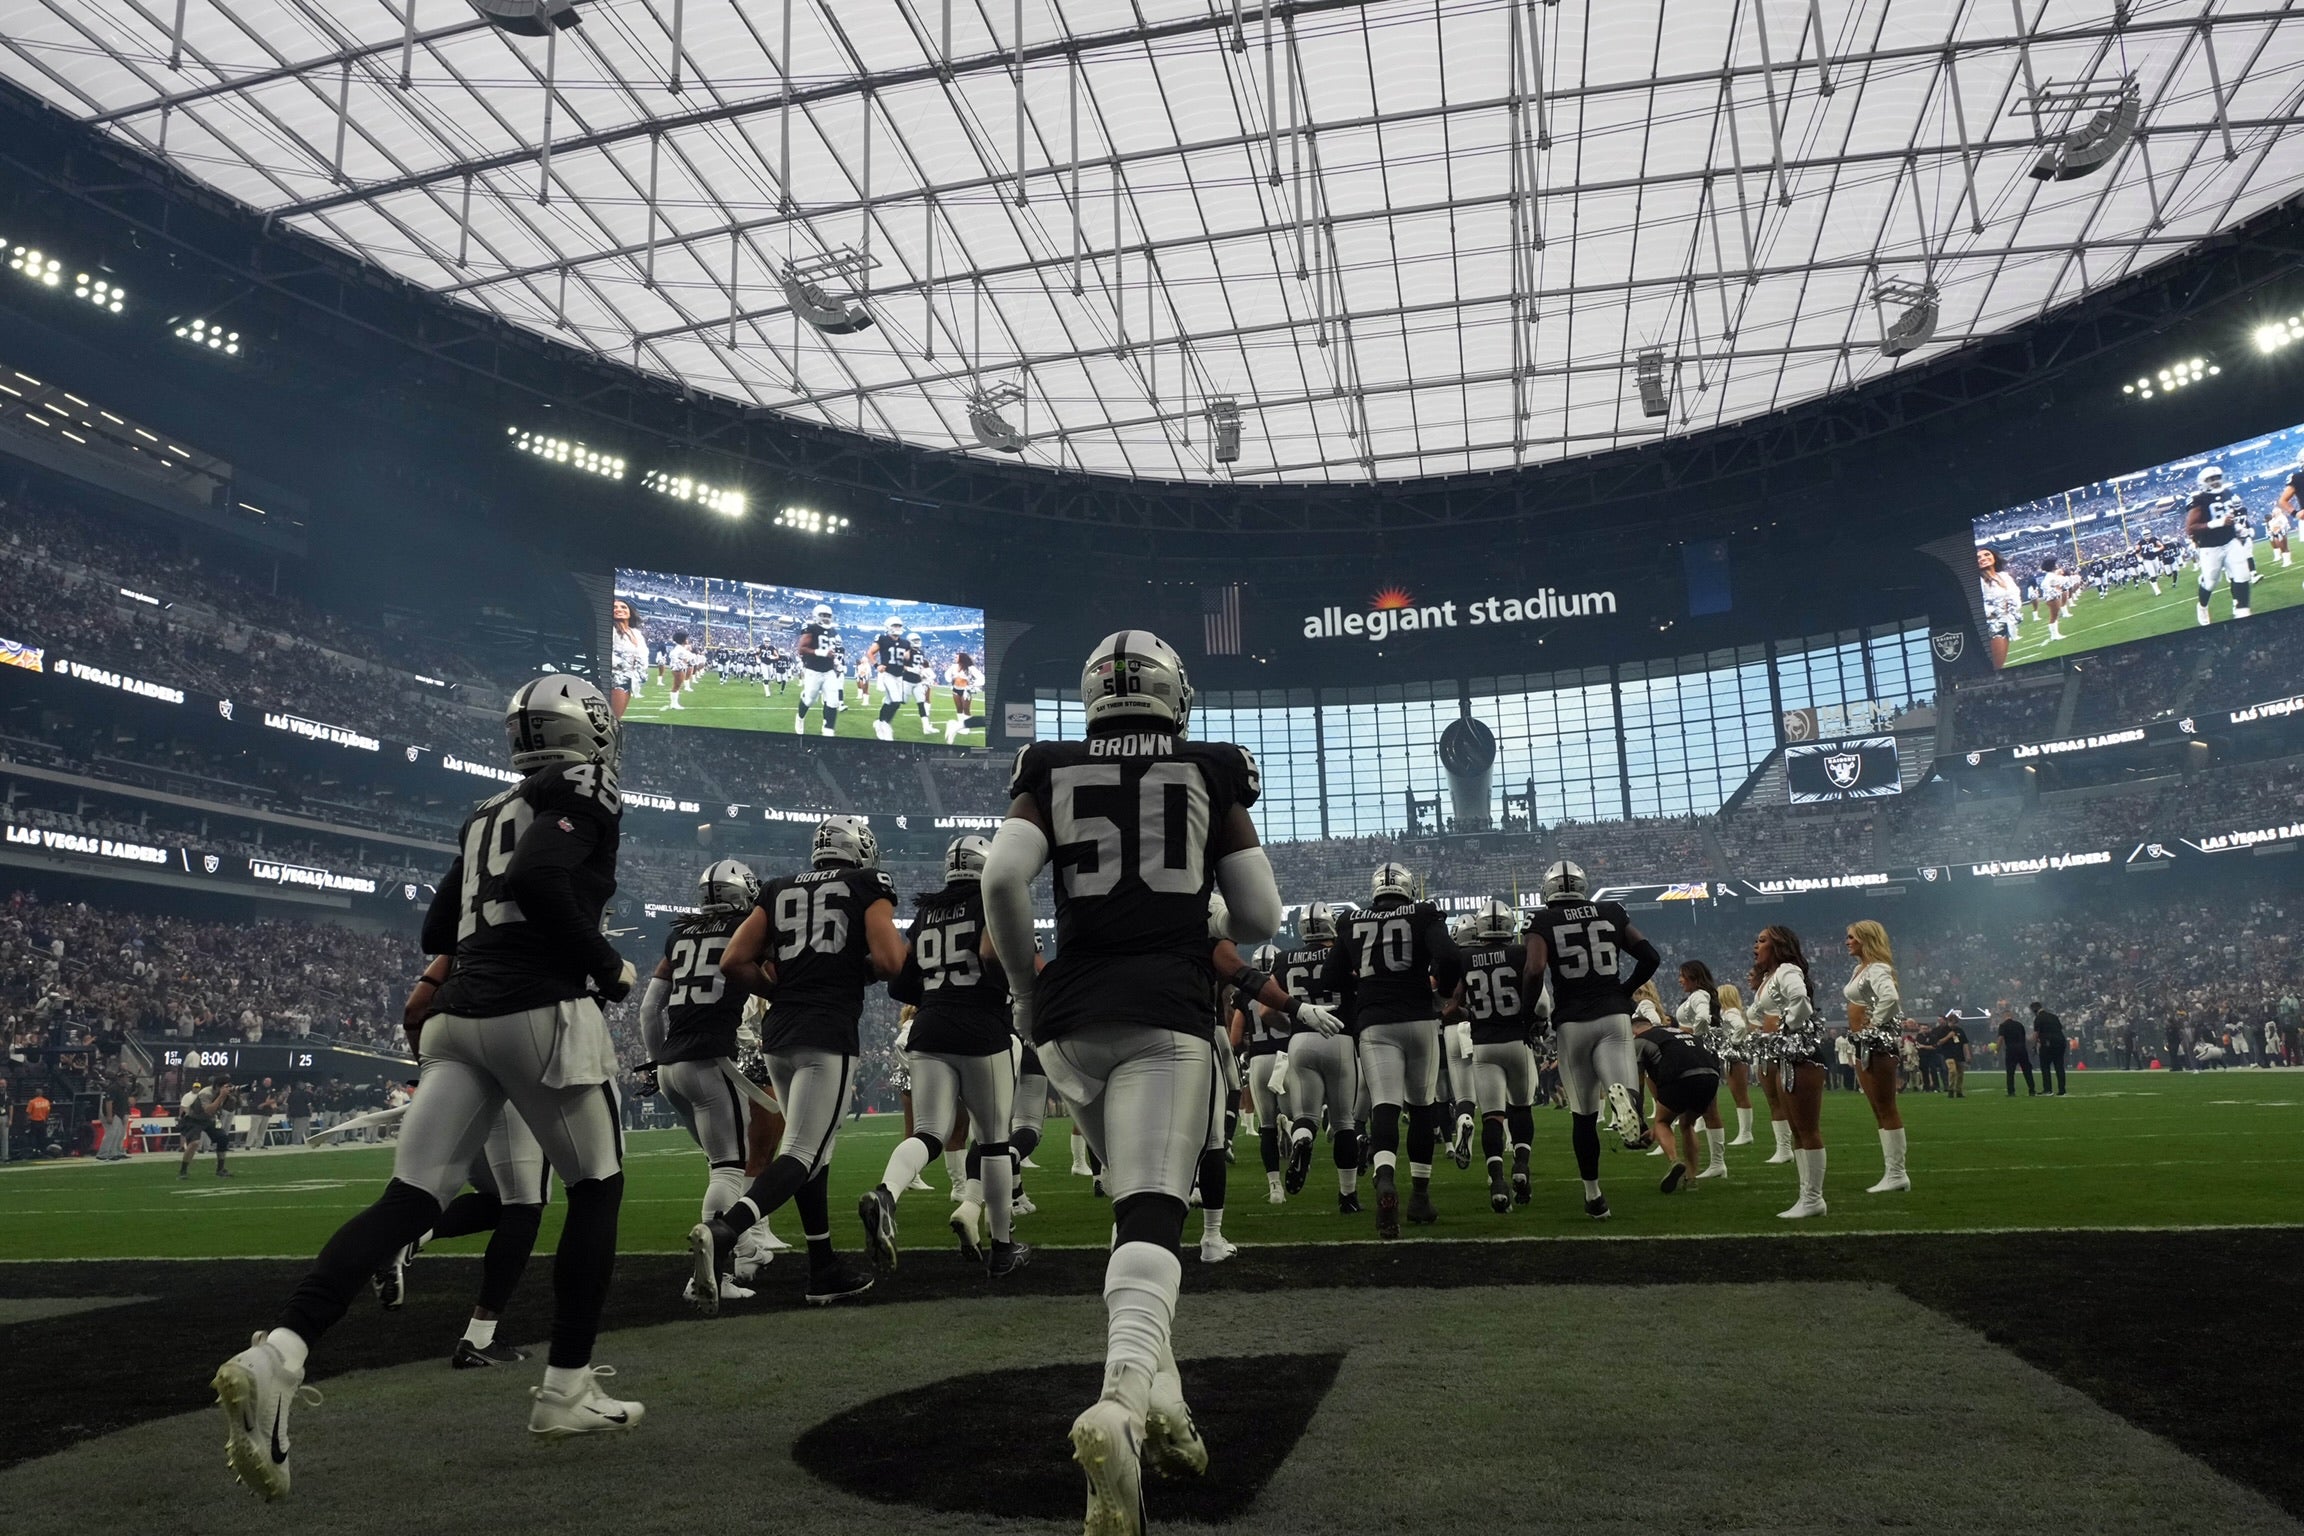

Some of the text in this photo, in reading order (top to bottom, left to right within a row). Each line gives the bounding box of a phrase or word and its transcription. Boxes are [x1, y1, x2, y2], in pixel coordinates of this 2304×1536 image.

[1303, 587, 1617, 641] allegiant stadium
[70, 662, 121, 688] VEGAS
[122, 677, 184, 704] RAIDERS
[1103, 676, 1140, 695] 50
[1821, 699, 1893, 728] MGM
[2230, 699, 2304, 723] LAS VEGAS
[265, 712, 380, 752] LAS VEGAS RAIDERS
[1089, 733, 1173, 757] BROWN
[2013, 729, 2145, 759] LAS VEGAS RAIDERS
[443, 756, 463, 772] LAS
[464, 761, 497, 779] VEGAS
[764, 810, 784, 821] LAS
[785, 811, 821, 822] VEGAS
[934, 818, 956, 828] LAS
[956, 818, 993, 828] VEGAS
[1051, 762, 1210, 898] 50
[2200, 836, 2228, 849] LAS
[2228, 828, 2277, 846] VEGAS
[6, 825, 167, 864] LAS VEGAS RAIDERS
[949, 861, 967, 870] 95
[1972, 851, 2111, 876] LAS VEGAS RAIDERS
[254, 863, 376, 893] LAS VEGAS RAIDERS
[794, 869, 841, 884] BOWER
[1759, 873, 1888, 892] LAS VEGAS RAIDERS
[673, 906, 692, 914] PLEASE
[1439, 897, 1450, 911] TO
[1519, 892, 1541, 907] 8:06
[644, 910, 657, 918] THE
[775, 881, 851, 961] 96
[926, 902, 966, 925] VICKERS
[1563, 905, 1599, 921] GREEN
[917, 920, 982, 991] 95
[1352, 918, 1412, 979] 70
[1472, 950, 1506, 968] BOLTON
[1552, 920, 1618, 979] 56
[669, 937, 733, 1006] 25
[1465, 966, 1521, 1020] 36
[200, 1051, 228, 1066] 8:06
[299, 1054, 312, 1067] 25
